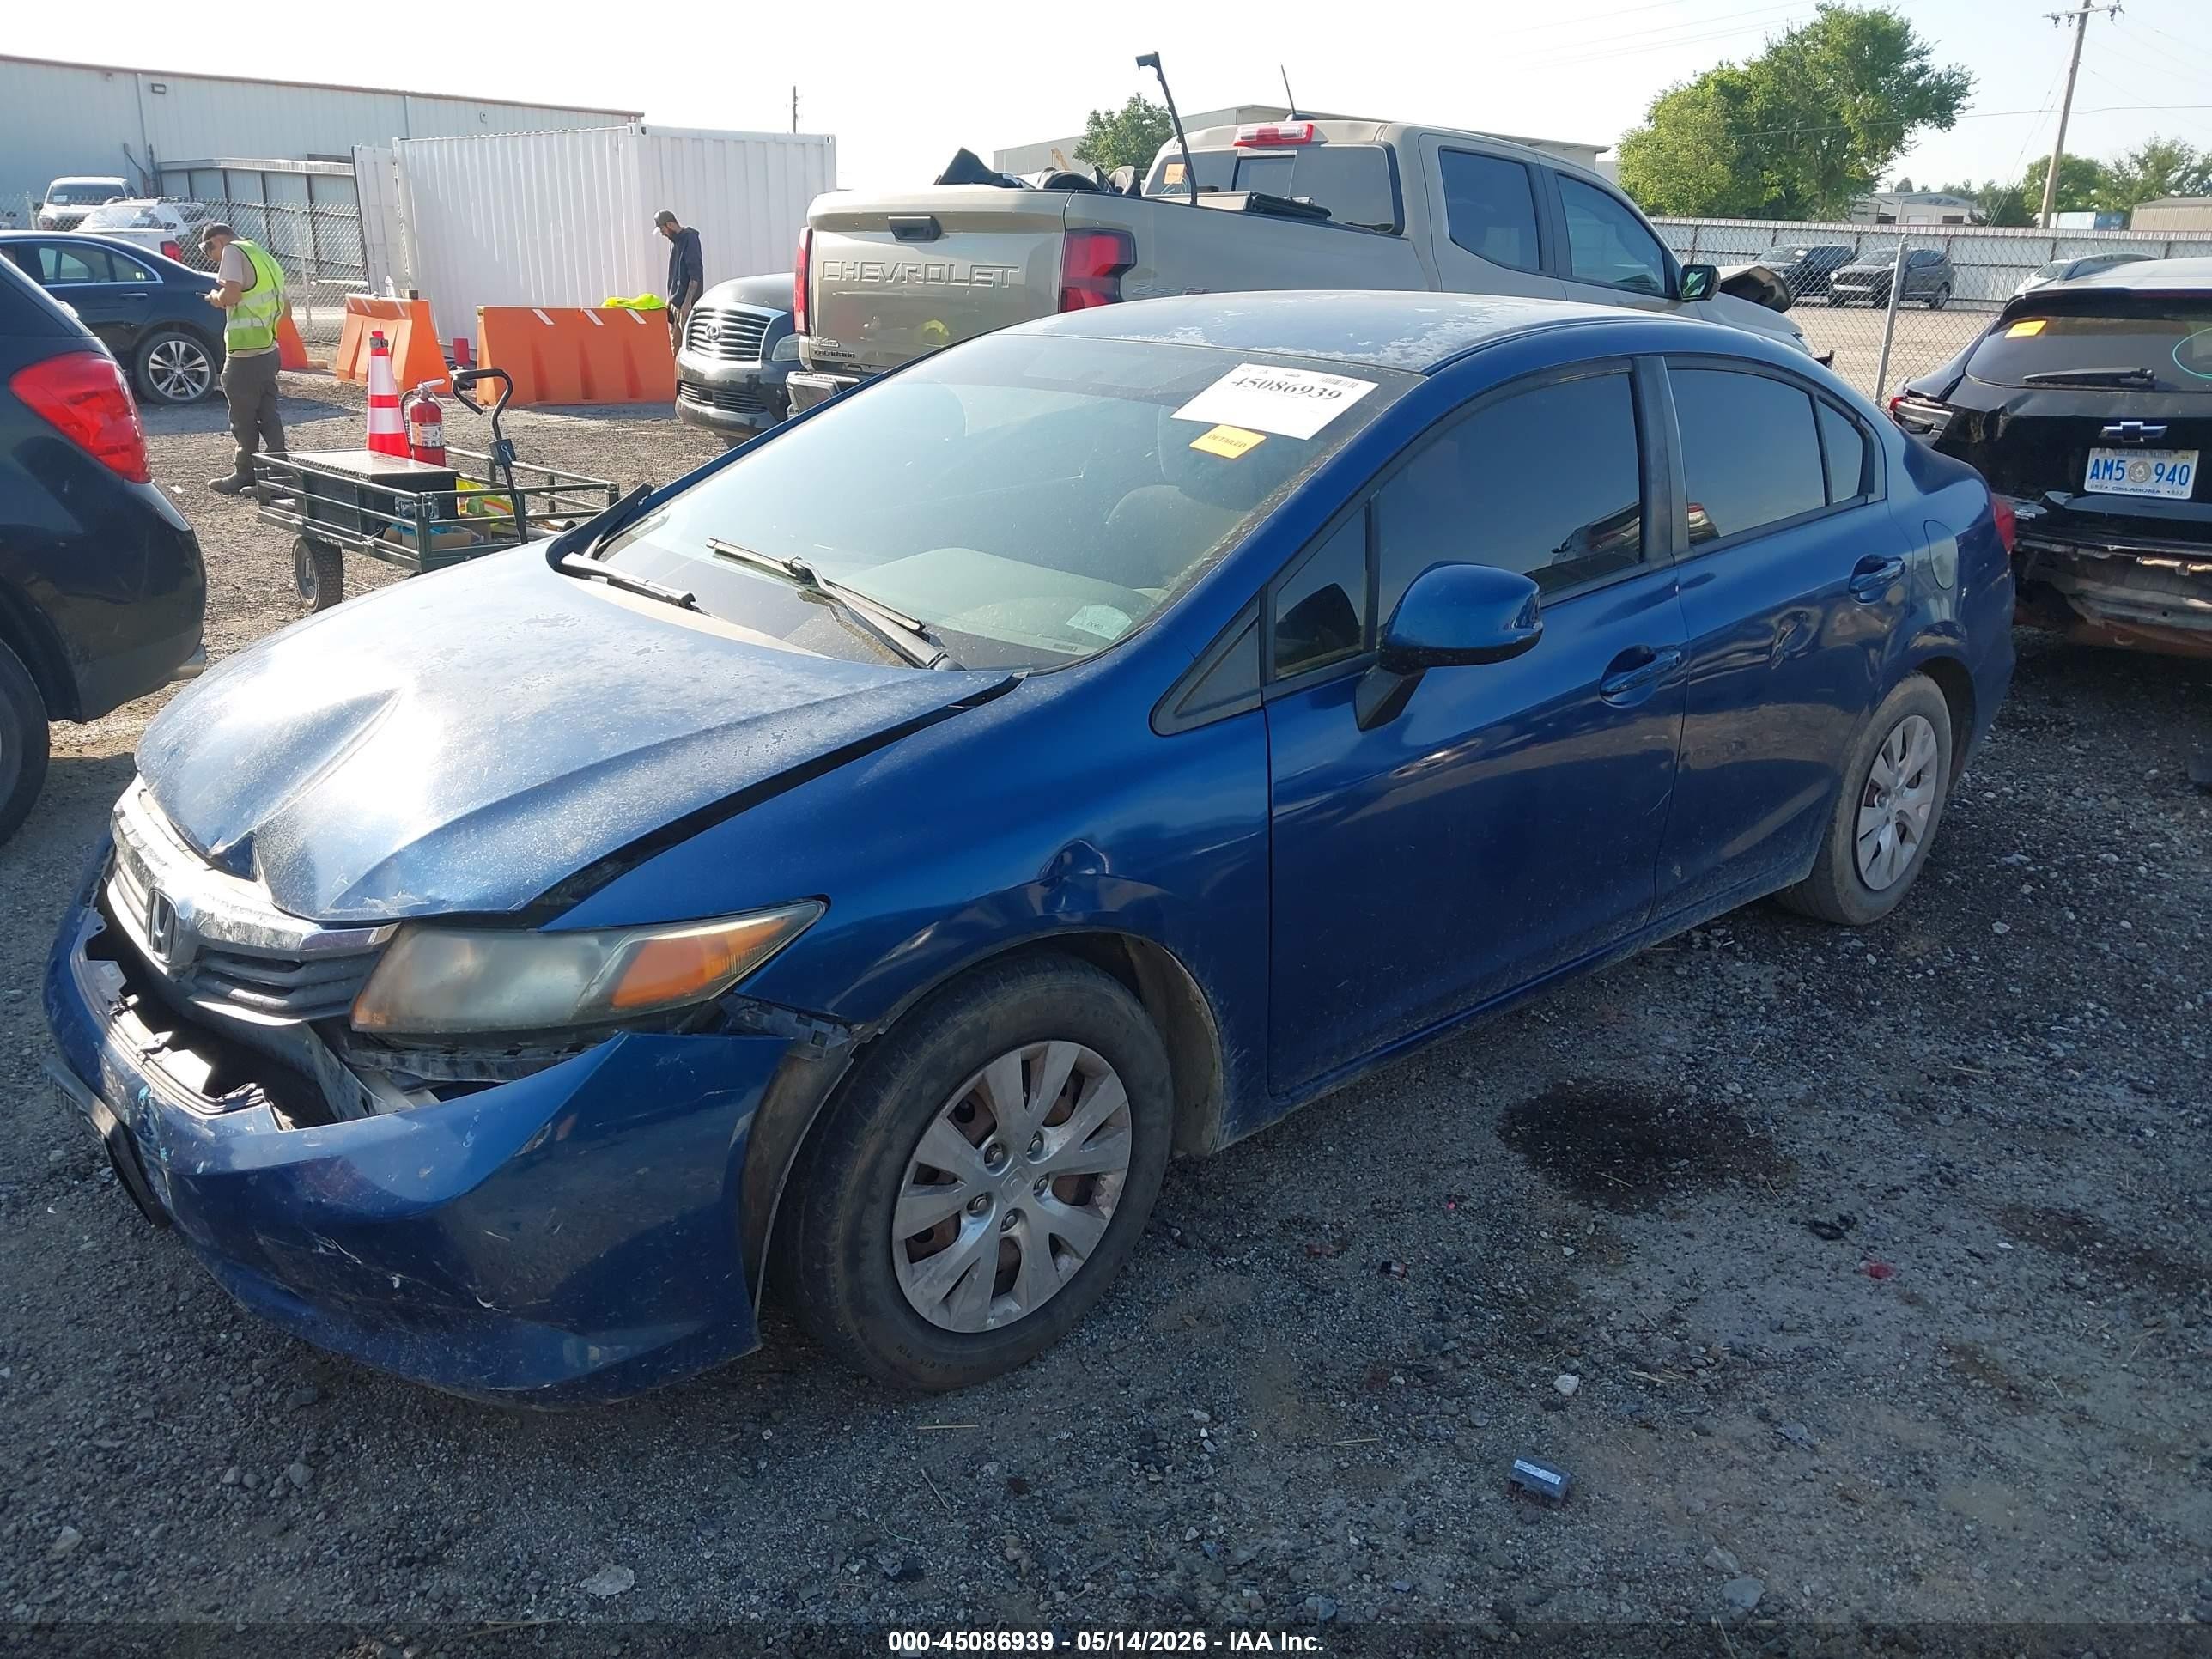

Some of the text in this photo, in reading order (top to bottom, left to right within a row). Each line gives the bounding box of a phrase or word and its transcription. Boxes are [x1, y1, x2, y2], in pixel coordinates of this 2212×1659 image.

[822, 260, 1020, 289] CHEVROLET
[1231, 376, 1343, 400] 45086939
[1207, 434, 1248, 448] DETAILED
[2089, 458, 2191, 487] AM5 940
[2111, 486, 2161, 495] OKLAHOMA
